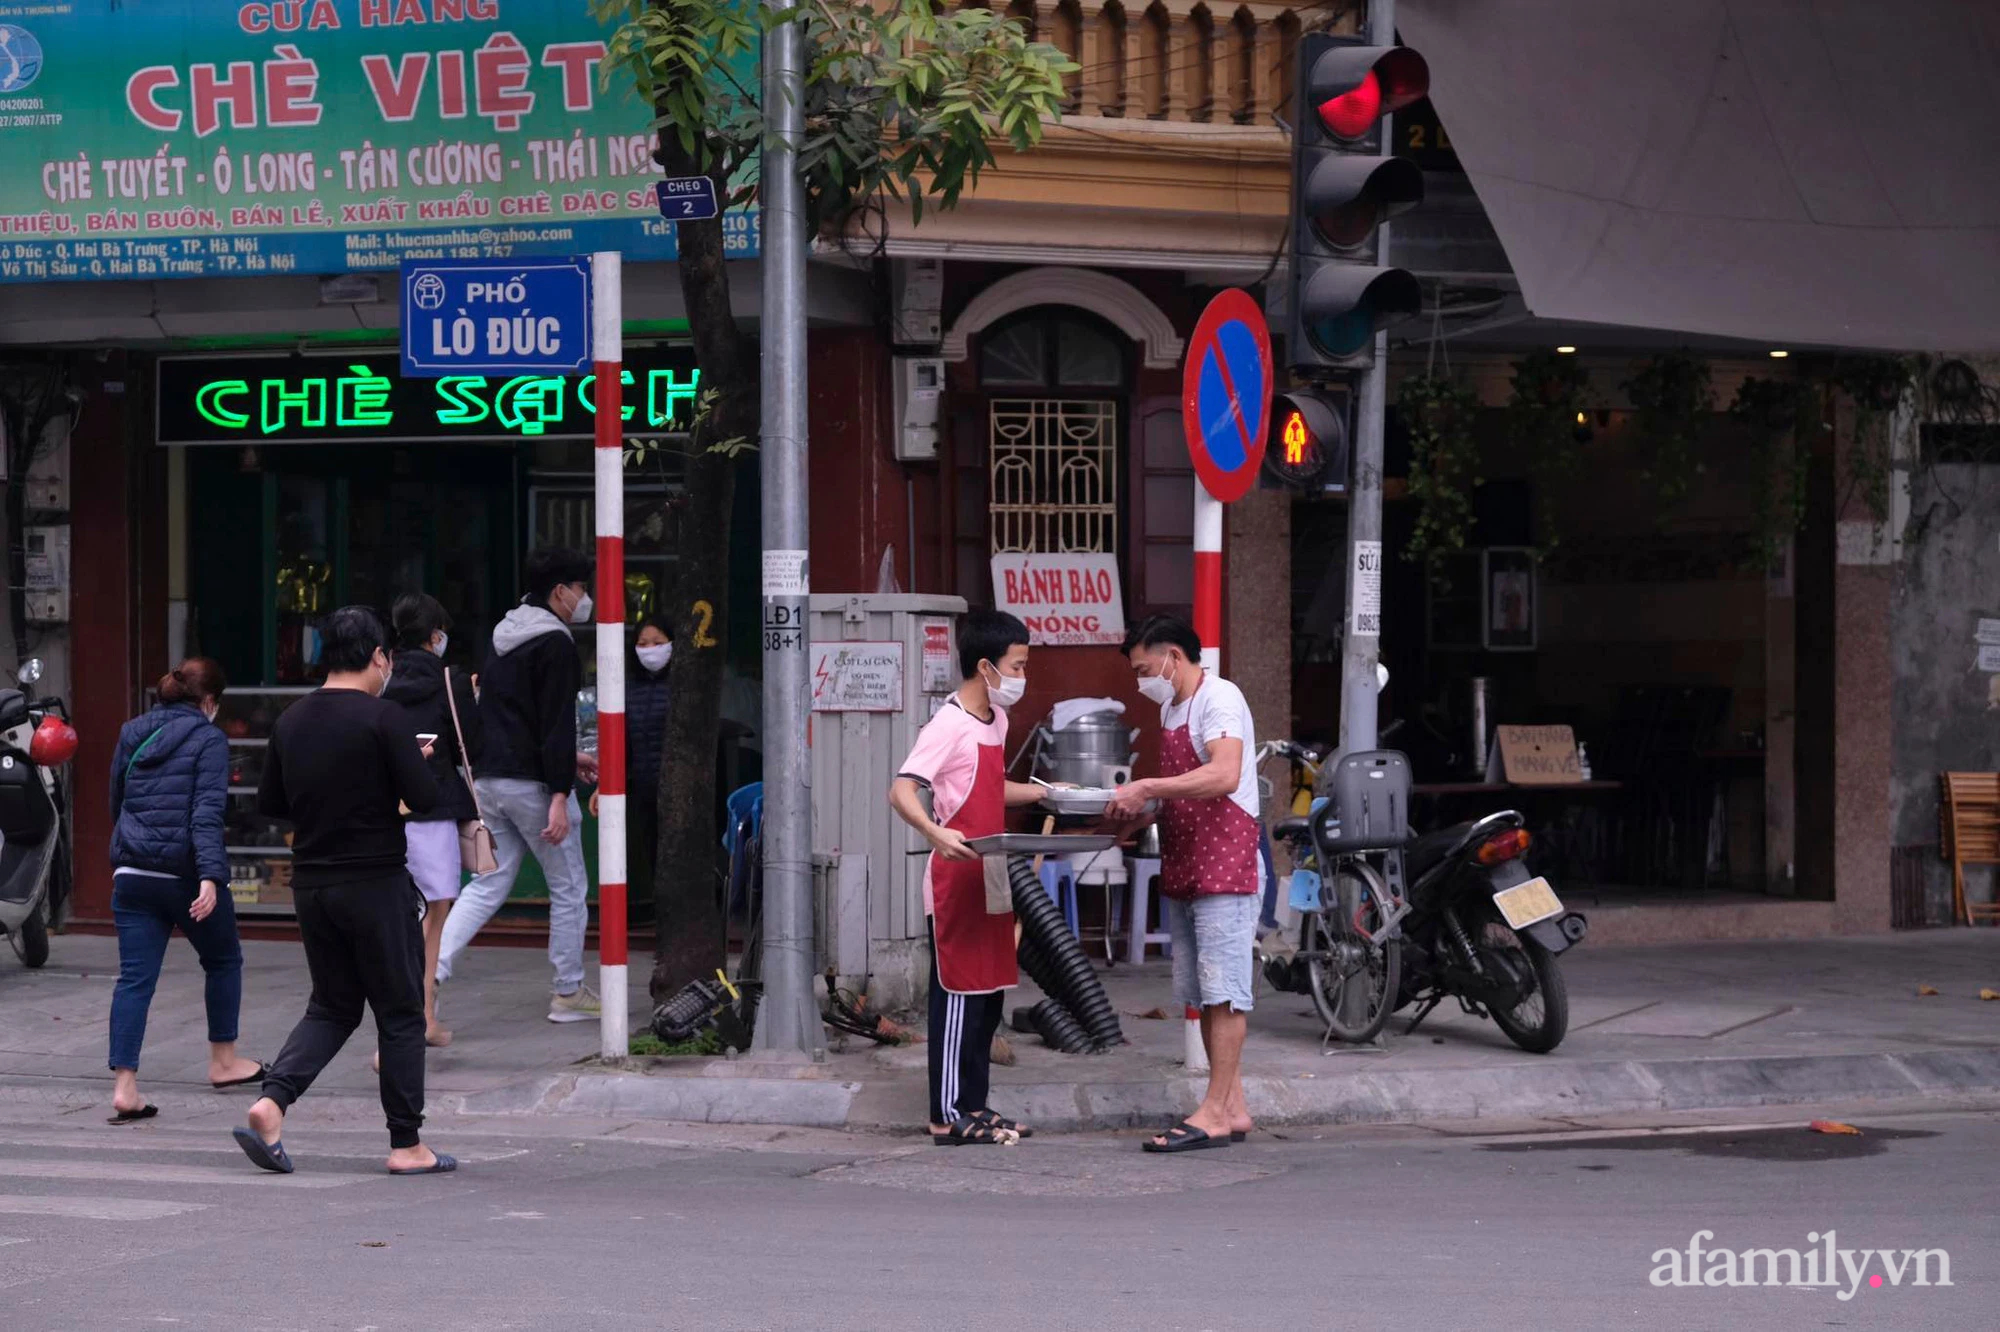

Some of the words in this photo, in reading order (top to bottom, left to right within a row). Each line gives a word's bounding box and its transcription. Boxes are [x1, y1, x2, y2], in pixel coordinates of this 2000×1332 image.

[126, 44, 323, 138] CHÈ
[360, 31, 608, 132] VIỆT
[42, 151, 93, 204] CHÈ
[101, 143, 188, 202] TUYẾT
[213, 145, 232, 195] Ô
[242, 152, 315, 194] LONG
[340, 140, 398, 194] TÂN
[407, 139, 502, 187] CƯƠNG
[527, 128, 598, 184] THÁI
[86, 207, 139, 233] BÁN
[146, 205, 222, 231] BUÔN,
[230, 203, 285, 228] BÁN
[342, 195, 409, 225] XUẤT
[418, 189, 491, 220] KHẨU
[498, 190, 552, 217] CHÈ
[562, 189, 619, 217] ĐẶC
[682, 201, 694, 214] 2
[345, 233, 381, 250] Mail:
[386, 227, 573, 249] khucmanhha@yahoo.com
[642, 220, 671, 236] Tel:
[56, 243, 71, 260] Q.
[75, 242, 98, 257] Hai
[102, 241, 120, 257] Bà
[125, 240, 168, 258] Trưng
[181, 239, 206, 254] TP.
[210, 237, 229, 253] Hà
[346, 250, 401, 268] Mobile:
[2, 261, 20, 276] Võ
[25, 260, 47, 278] Thị
[91, 259, 106, 276] Q.
[110, 258, 133, 273] Hai
[137, 257, 156, 273] Bà
[161, 256, 204, 273] Trưng
[217, 255, 242, 270] TP.
[246, 254, 266, 270] Hà
[270, 253, 295, 272] Nội
[466, 273, 527, 304] PHỐ
[432, 308, 476, 355] LÒ
[486, 308, 561, 355] ĐÚC
[195, 365, 394, 434] CHÈ
[1004, 559, 1065, 605] BÁNH
[1067, 567, 1112, 604] BAO
[691, 599, 719, 649] 2
[764, 606, 801, 625] LĐ1
[1023, 609, 1101, 634] NÓNG
